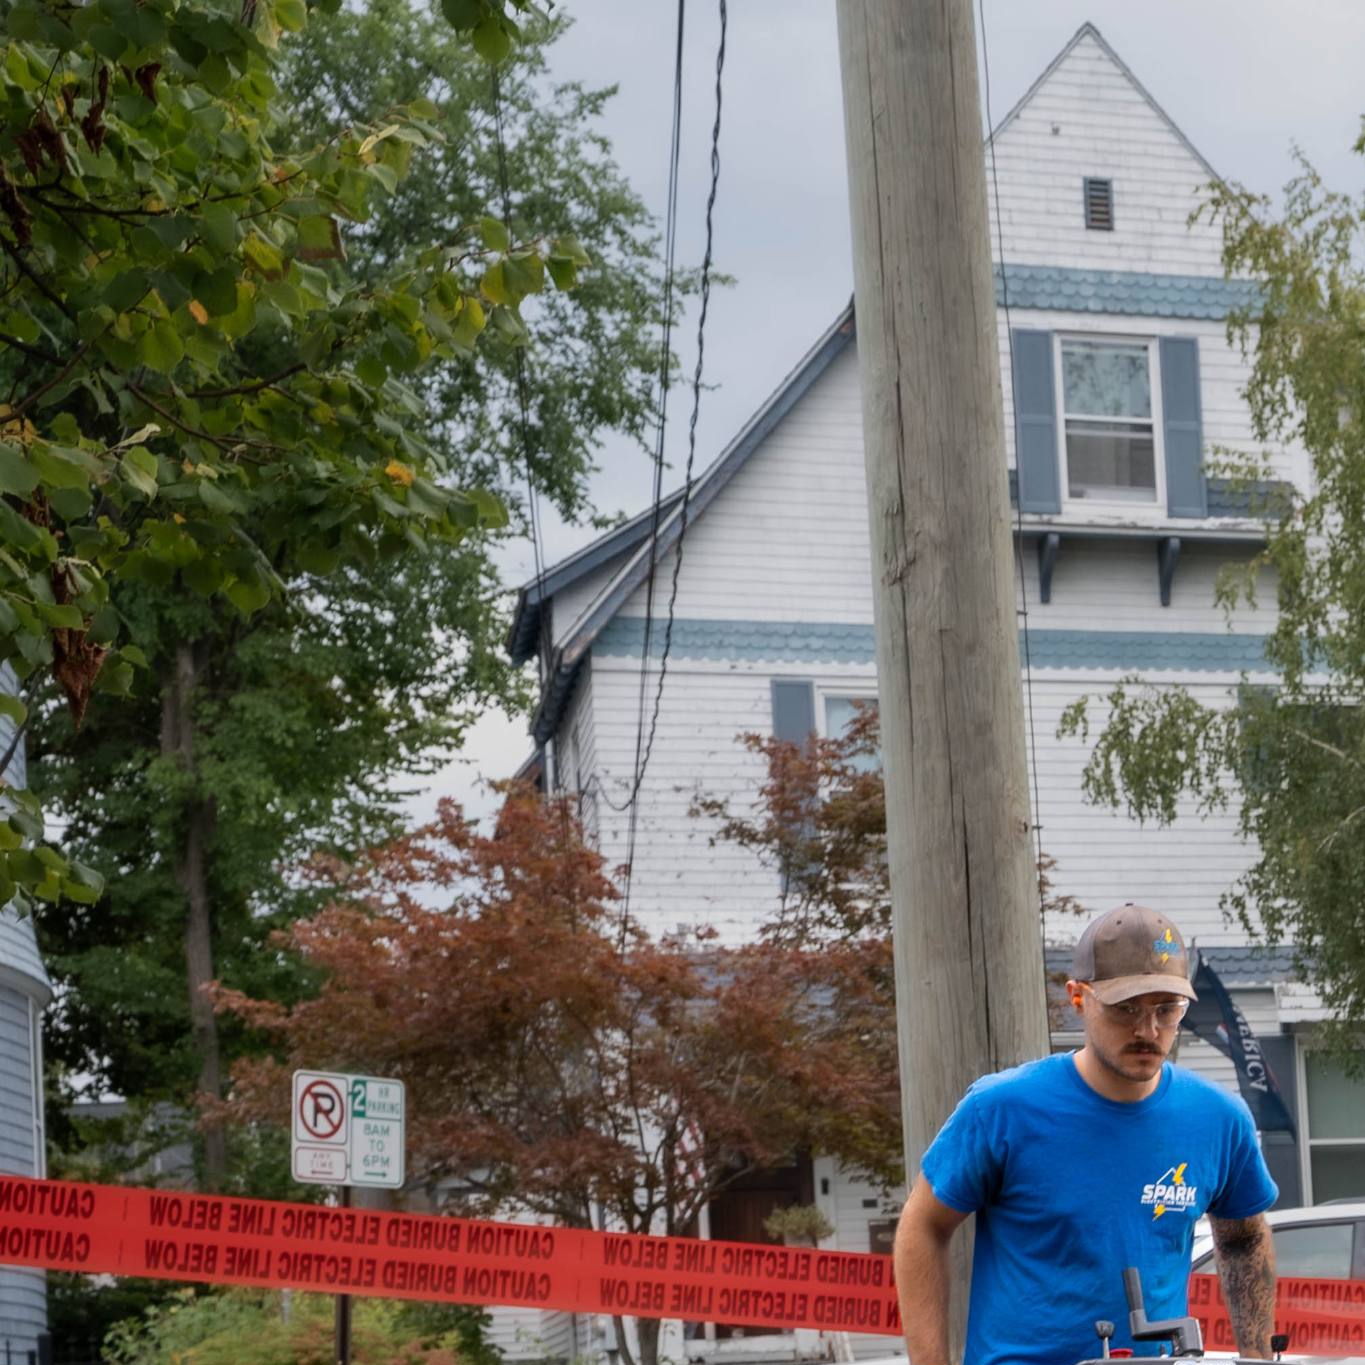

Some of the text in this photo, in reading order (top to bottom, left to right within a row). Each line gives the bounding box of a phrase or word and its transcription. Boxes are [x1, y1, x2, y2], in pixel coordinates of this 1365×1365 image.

[353, 1083, 366, 1112] 2
[367, 1100, 400, 1115] PARKING
[363, 1122, 391, 1137] 8AM
[370, 1139, 385, 1152] TO
[362, 1154, 391, 1168] 6PM
[1142, 1184, 1198, 1201] SPARK
